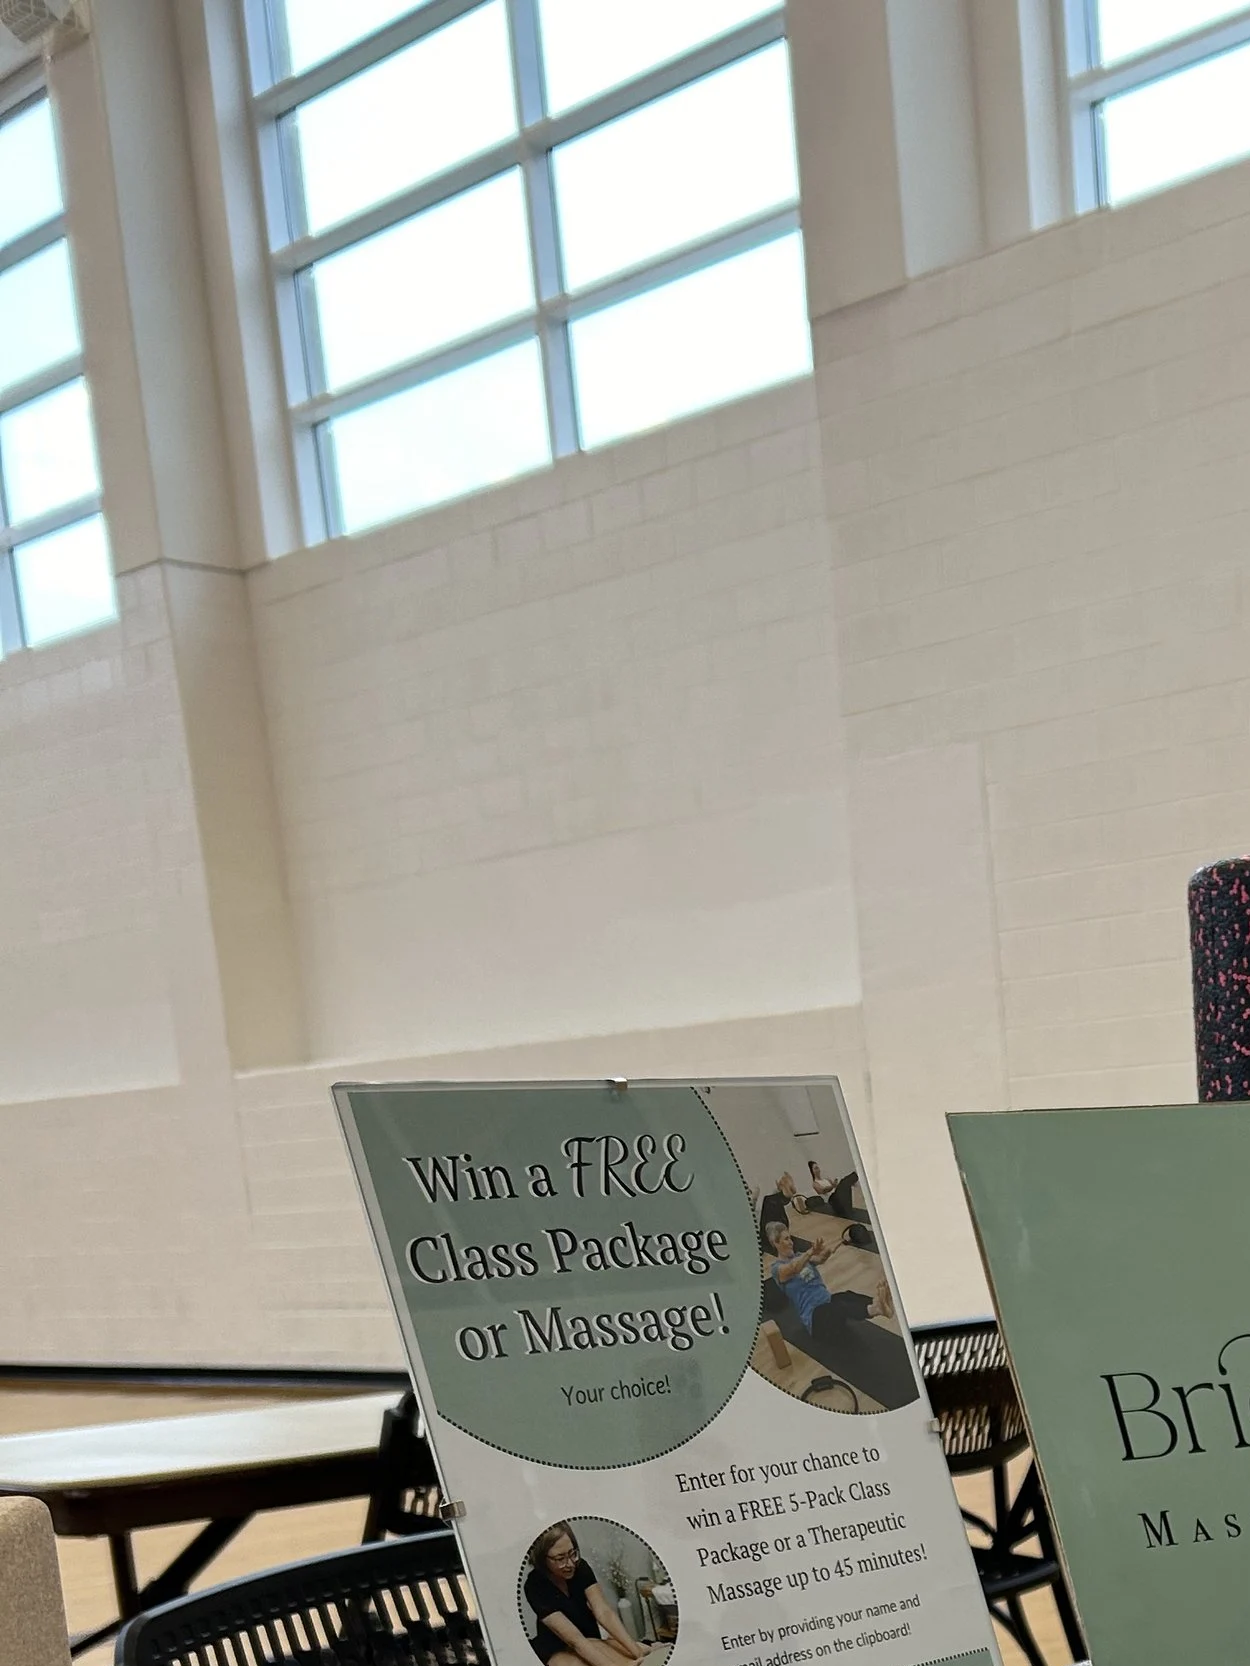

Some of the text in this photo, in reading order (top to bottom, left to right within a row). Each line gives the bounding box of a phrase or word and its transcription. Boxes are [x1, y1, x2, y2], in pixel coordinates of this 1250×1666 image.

[402, 1133, 694, 1203] Win a FREE
[406, 1221, 730, 1284] Class Package
[455, 1292, 730, 1362] or Massage!
[561, 1374, 671, 1406] Your choice!
[675, 1447, 880, 1493] Enter for your chance to
[686, 1481, 891, 1530] win a FREE 5-Pack Class
[696, 1512, 907, 1568] Package or a Therapeutic
[707, 1543, 928, 1605] Massage up to 45 minutes!
[721, 1594, 921, 1651] Enter by providing your name and
[816, 1642, 832, 1657] on
[834, 1635, 854, 1653] the
[856, 1622, 912, 1649] clipboard!
